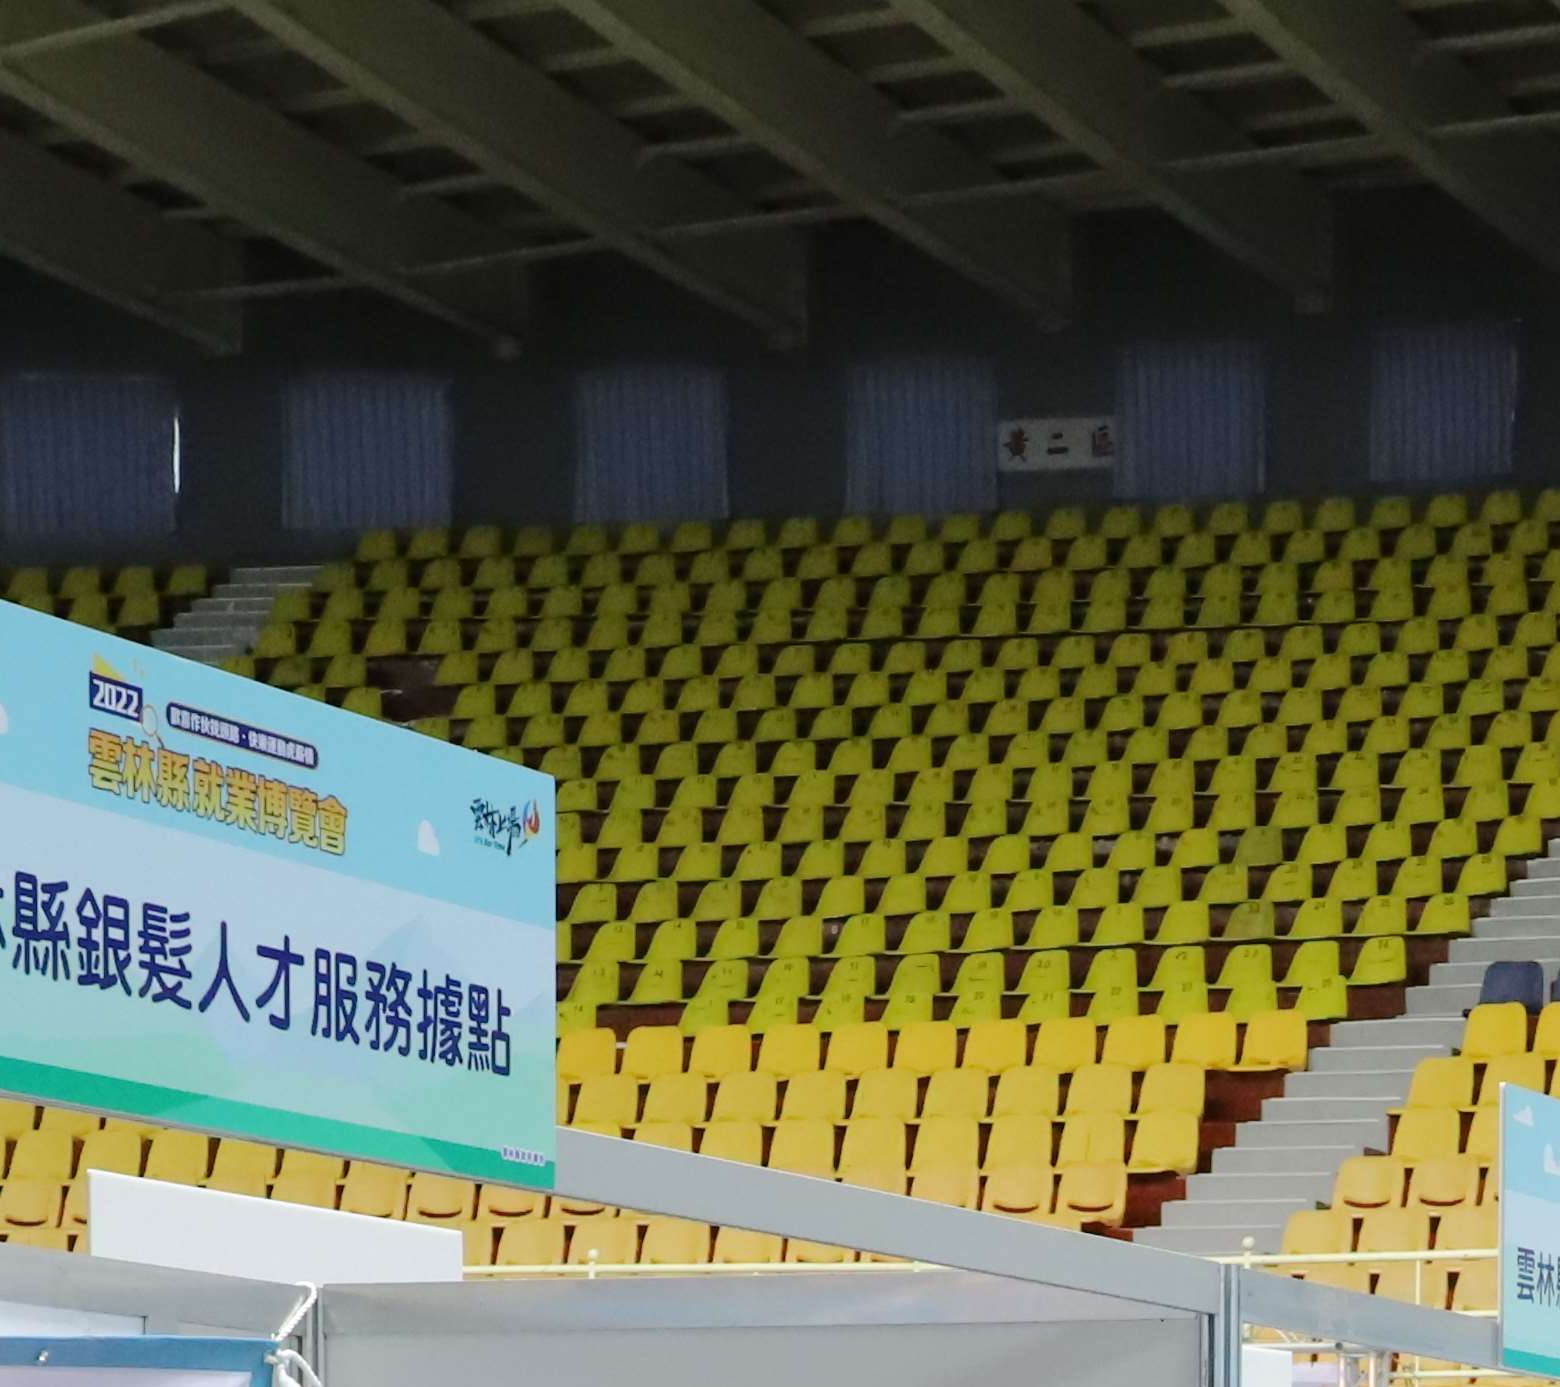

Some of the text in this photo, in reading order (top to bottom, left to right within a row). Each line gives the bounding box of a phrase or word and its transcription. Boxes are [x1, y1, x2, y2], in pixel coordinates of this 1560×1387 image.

[91, 676, 141, 719] 2022
[88, 728, 348, 856] 雲林縣就業博覽會
